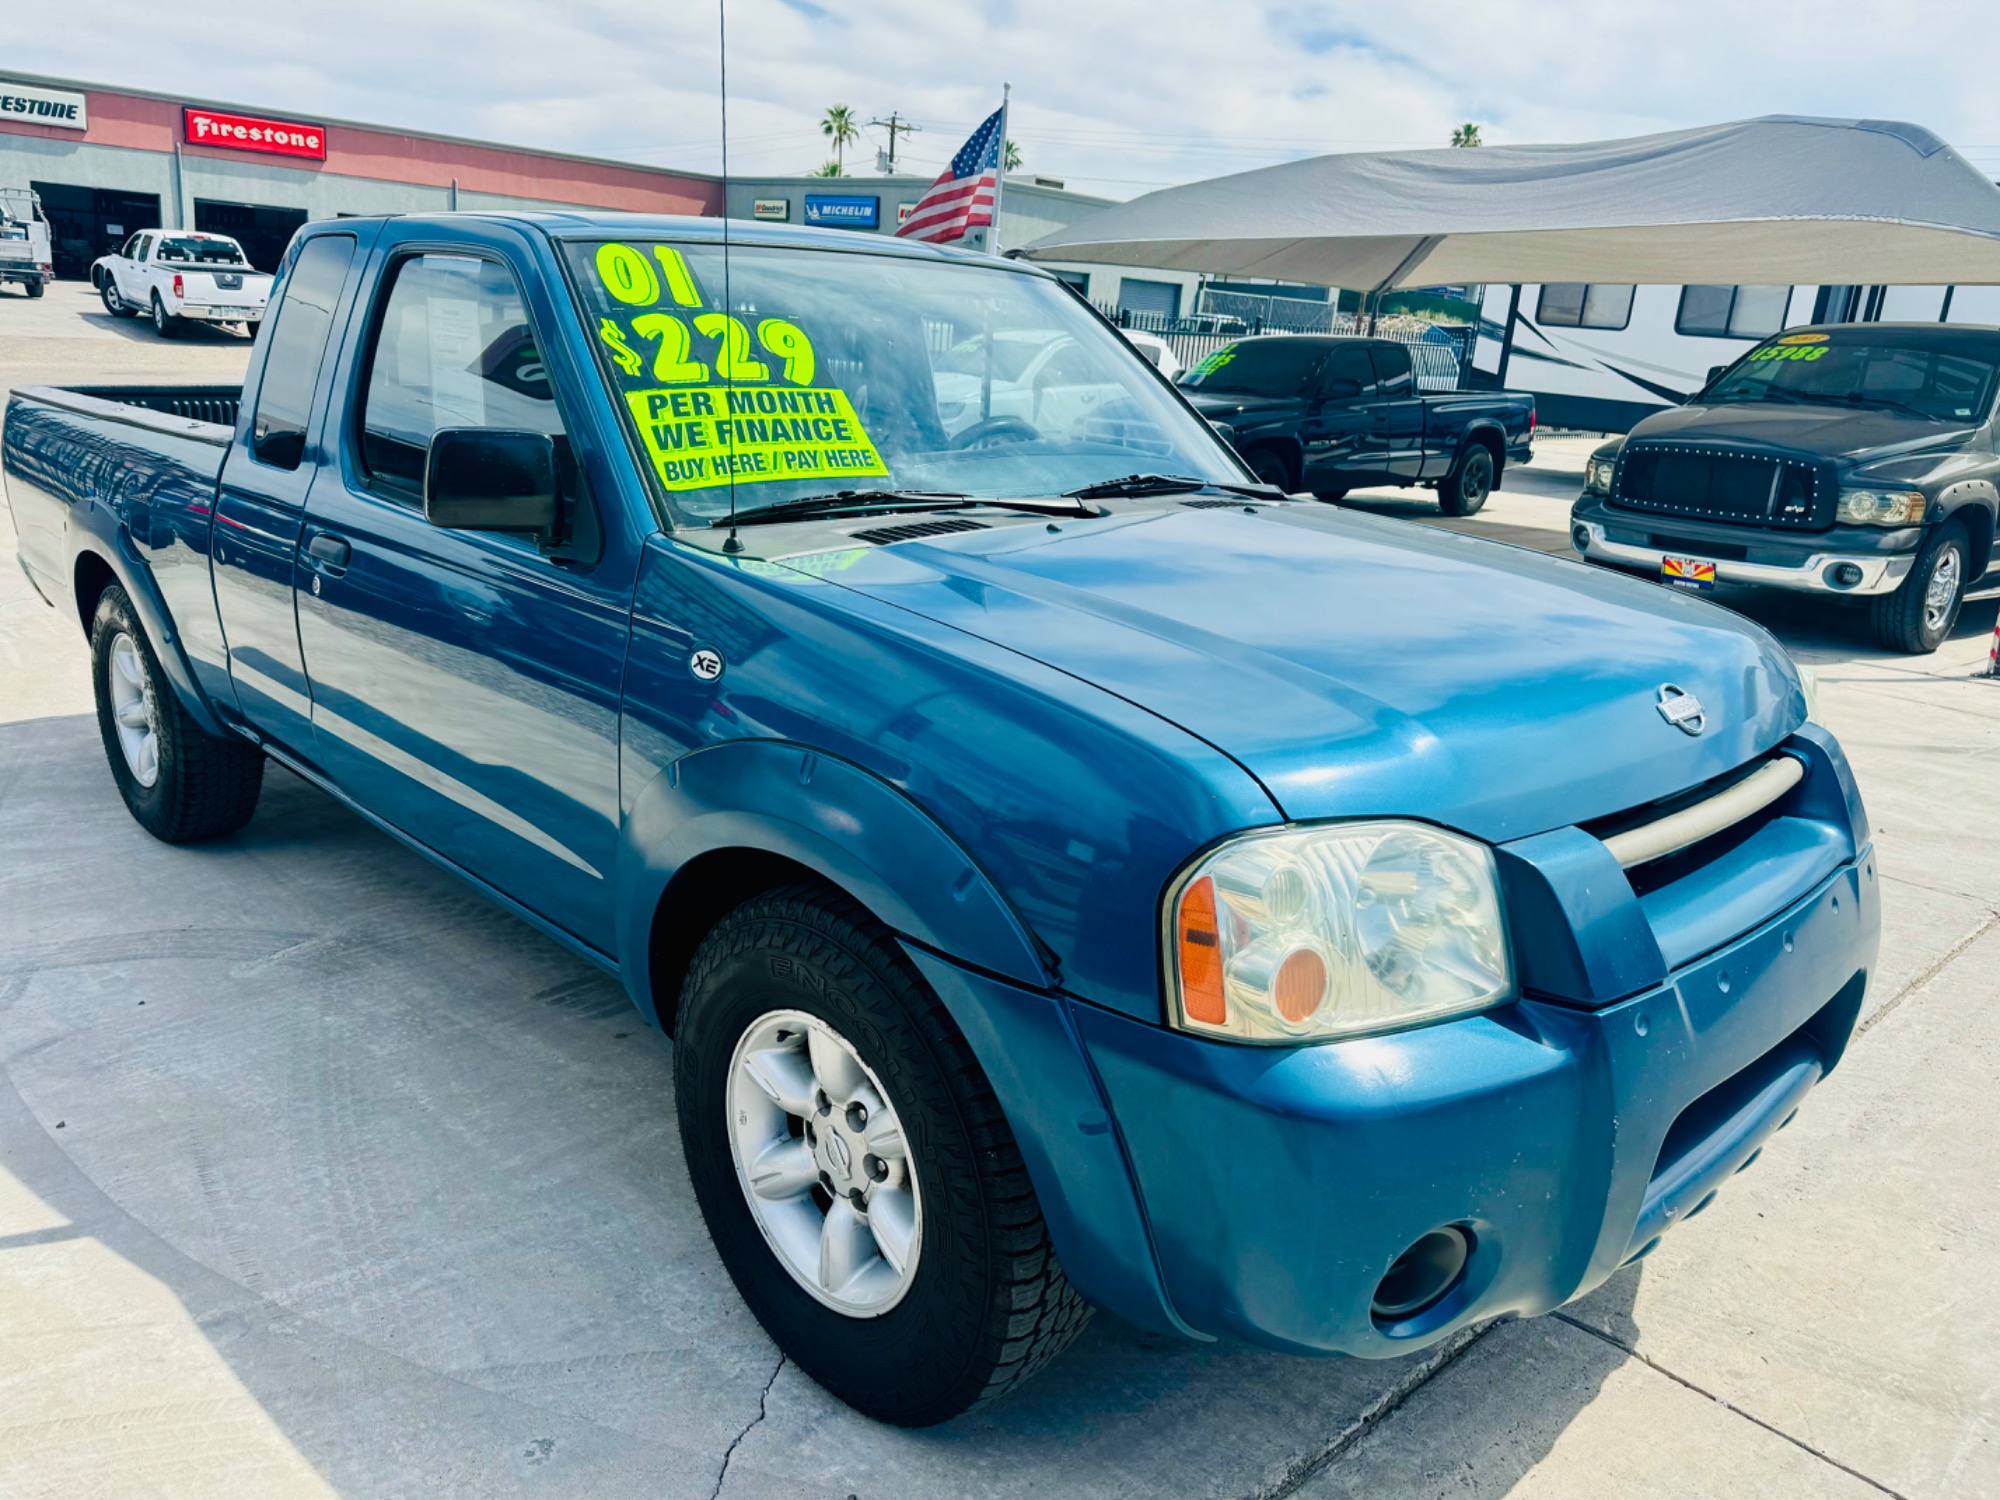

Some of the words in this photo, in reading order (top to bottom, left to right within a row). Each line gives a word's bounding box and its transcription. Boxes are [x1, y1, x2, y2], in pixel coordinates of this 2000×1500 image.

[0, 95, 79, 120] ESTONE
[193, 117, 320, 148] Firestone
[821, 205, 872, 217] MICHELIN
[596, 243, 703, 308] 01
[600, 313, 815, 386] $229
[647, 392, 716, 420] PER
[725, 391, 838, 415] MONTH
[651, 421, 707, 451] WE
[714, 418, 852, 445] FINANCE
[664, 457, 706, 482] BUY
[711, 452, 767, 476] HERE
[783, 450, 821, 470] PAY
[826, 449, 876, 468] HERE
[693, 654, 719, 675] XE
